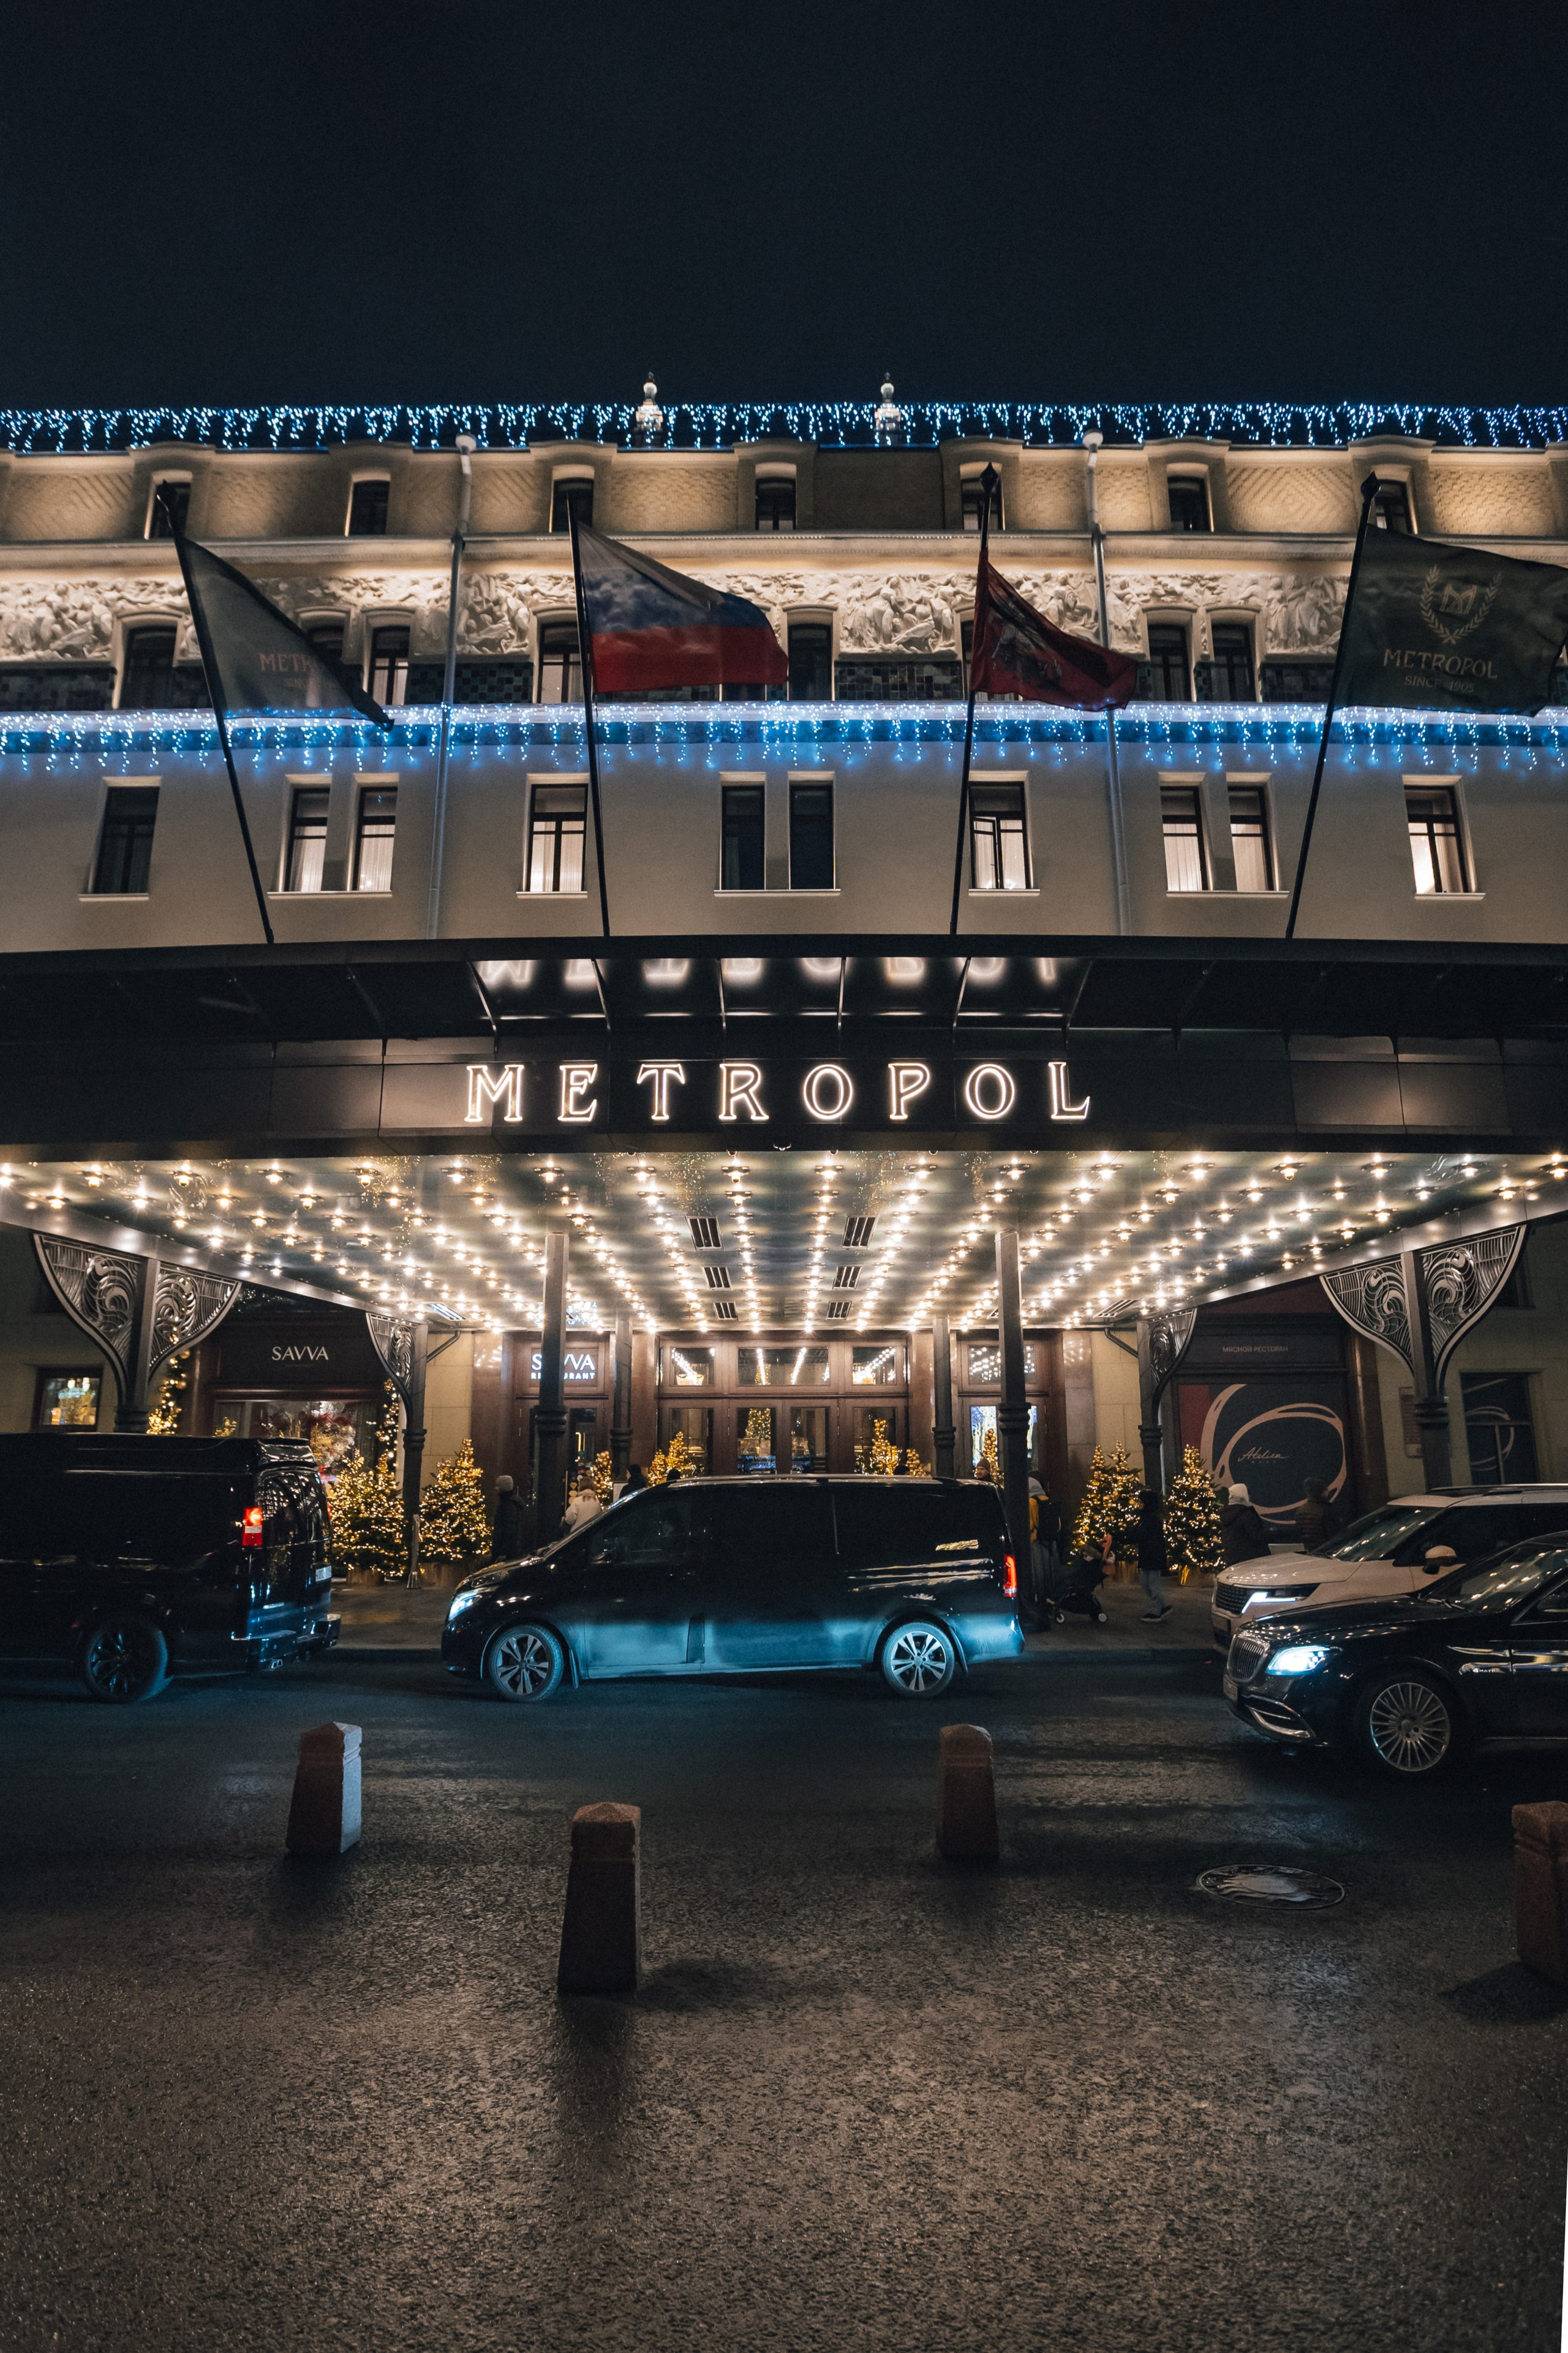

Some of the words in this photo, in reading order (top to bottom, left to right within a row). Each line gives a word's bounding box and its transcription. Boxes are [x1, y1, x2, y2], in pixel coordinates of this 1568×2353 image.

[1383, 649, 1498, 679] METROPOL
[1404, 675, 1439, 687] SINCE
[1449, 681, 1476, 693] 1905
[464, 1062, 1091, 1122] METROPOL
[271, 1346, 329, 1361] SAVVA
[1237, 1446, 1290, 1462] Atelier
